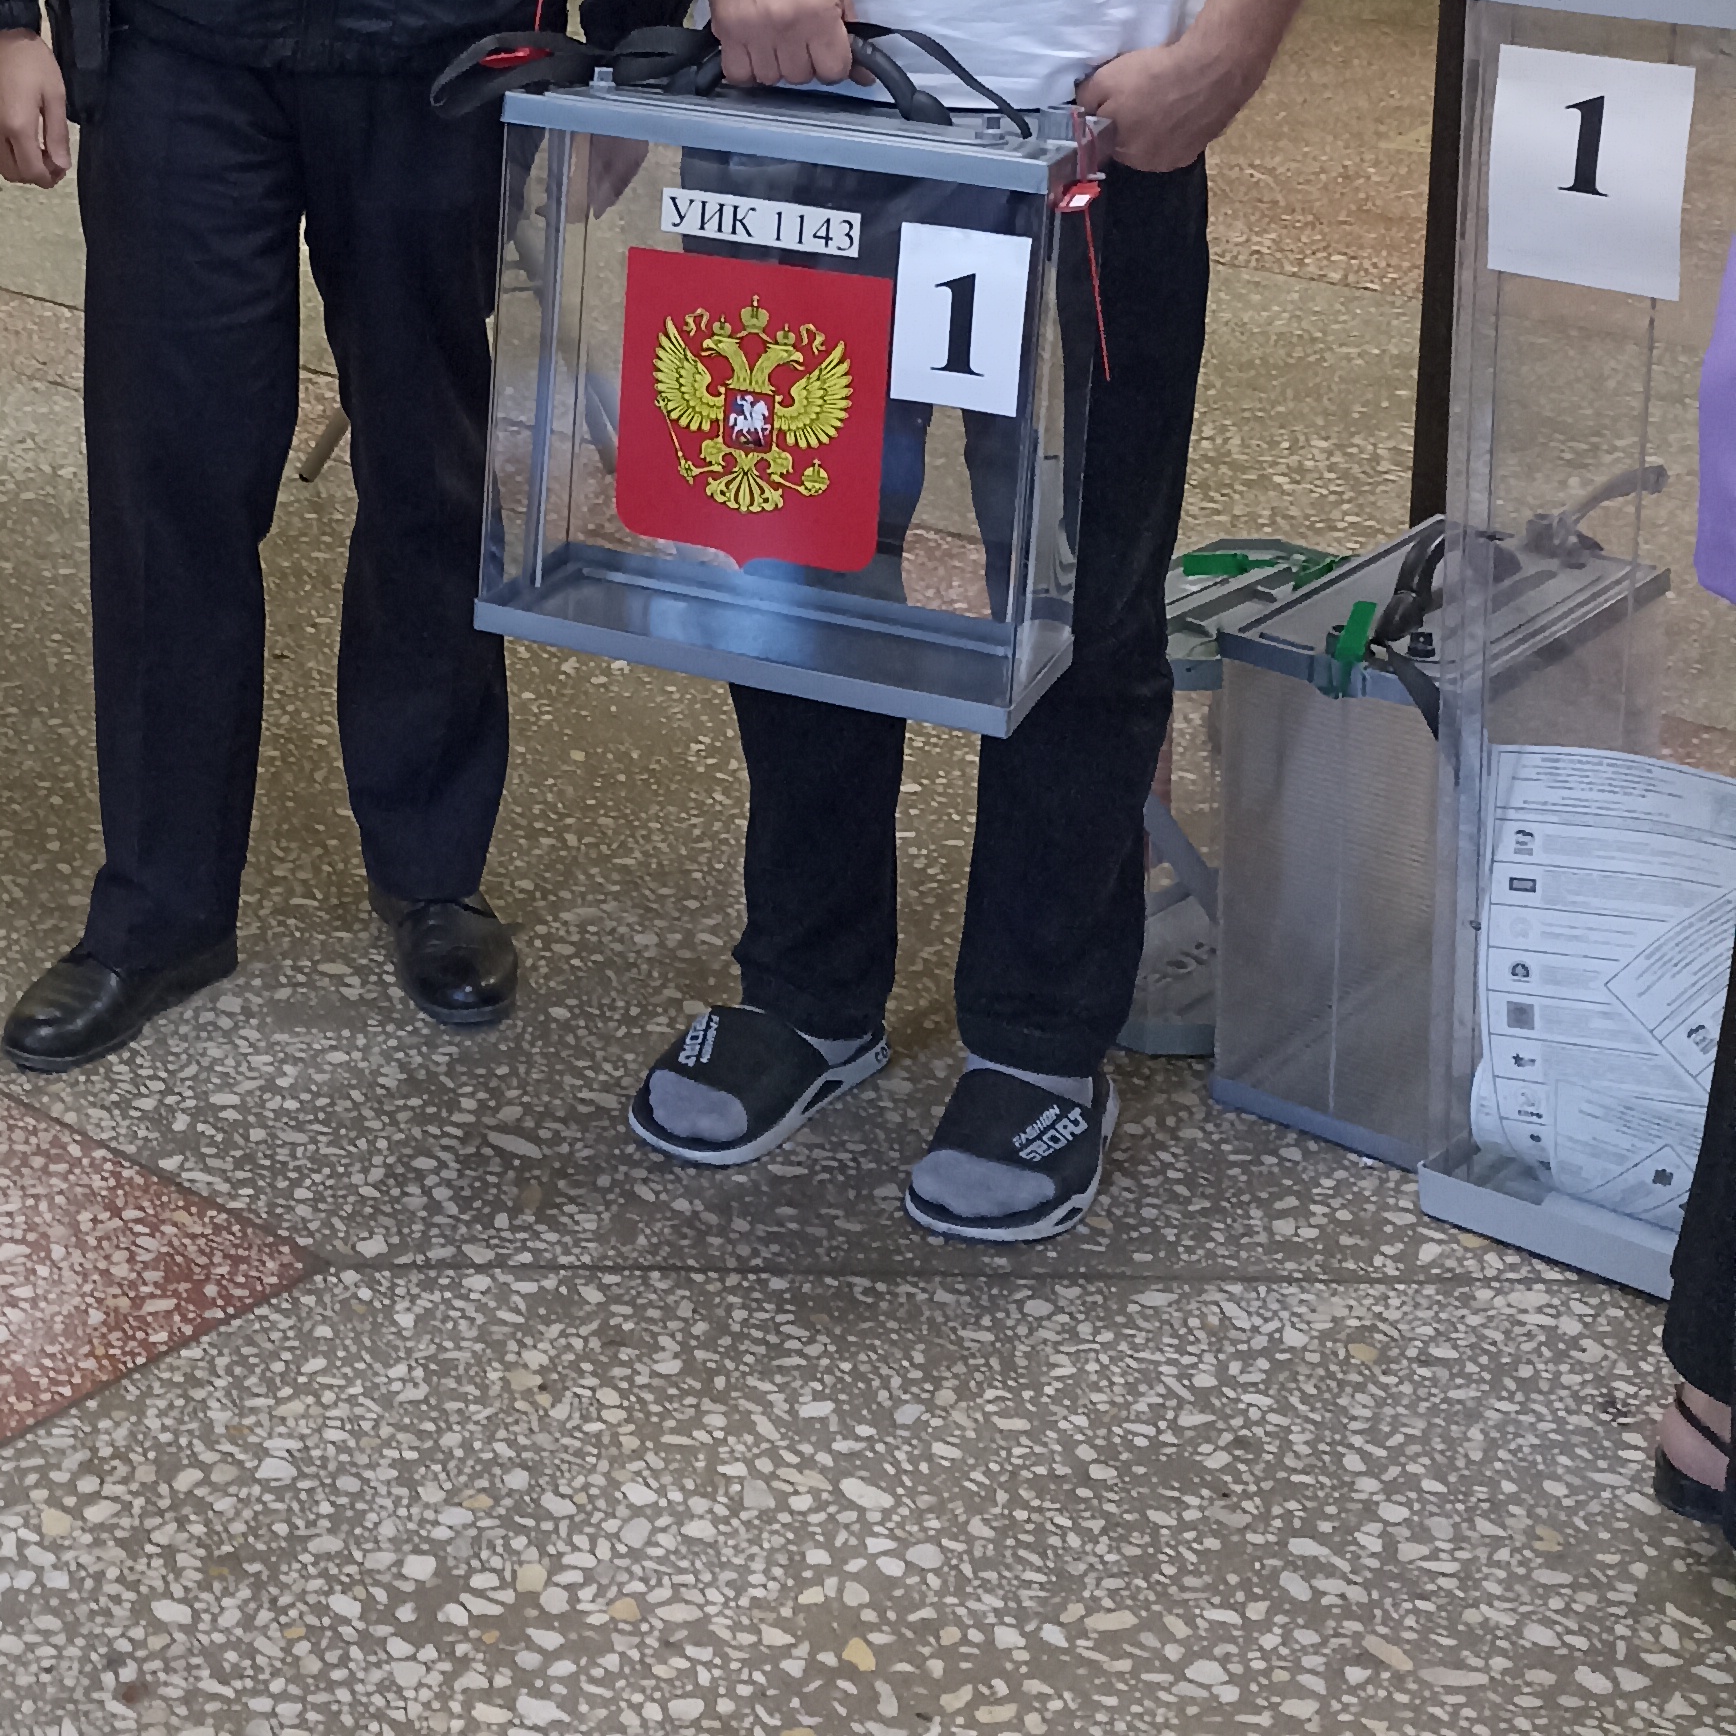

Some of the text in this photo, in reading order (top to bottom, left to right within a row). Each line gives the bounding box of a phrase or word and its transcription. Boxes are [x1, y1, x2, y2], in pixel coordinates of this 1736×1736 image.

[1557, 95, 1609, 197] 1
[668, 195, 855, 252] УИК 1143
[929, 272, 985, 377] 1
[1012, 1104, 1060, 1148] FASHION
[1019, 1107, 1088, 1161] SPORT
